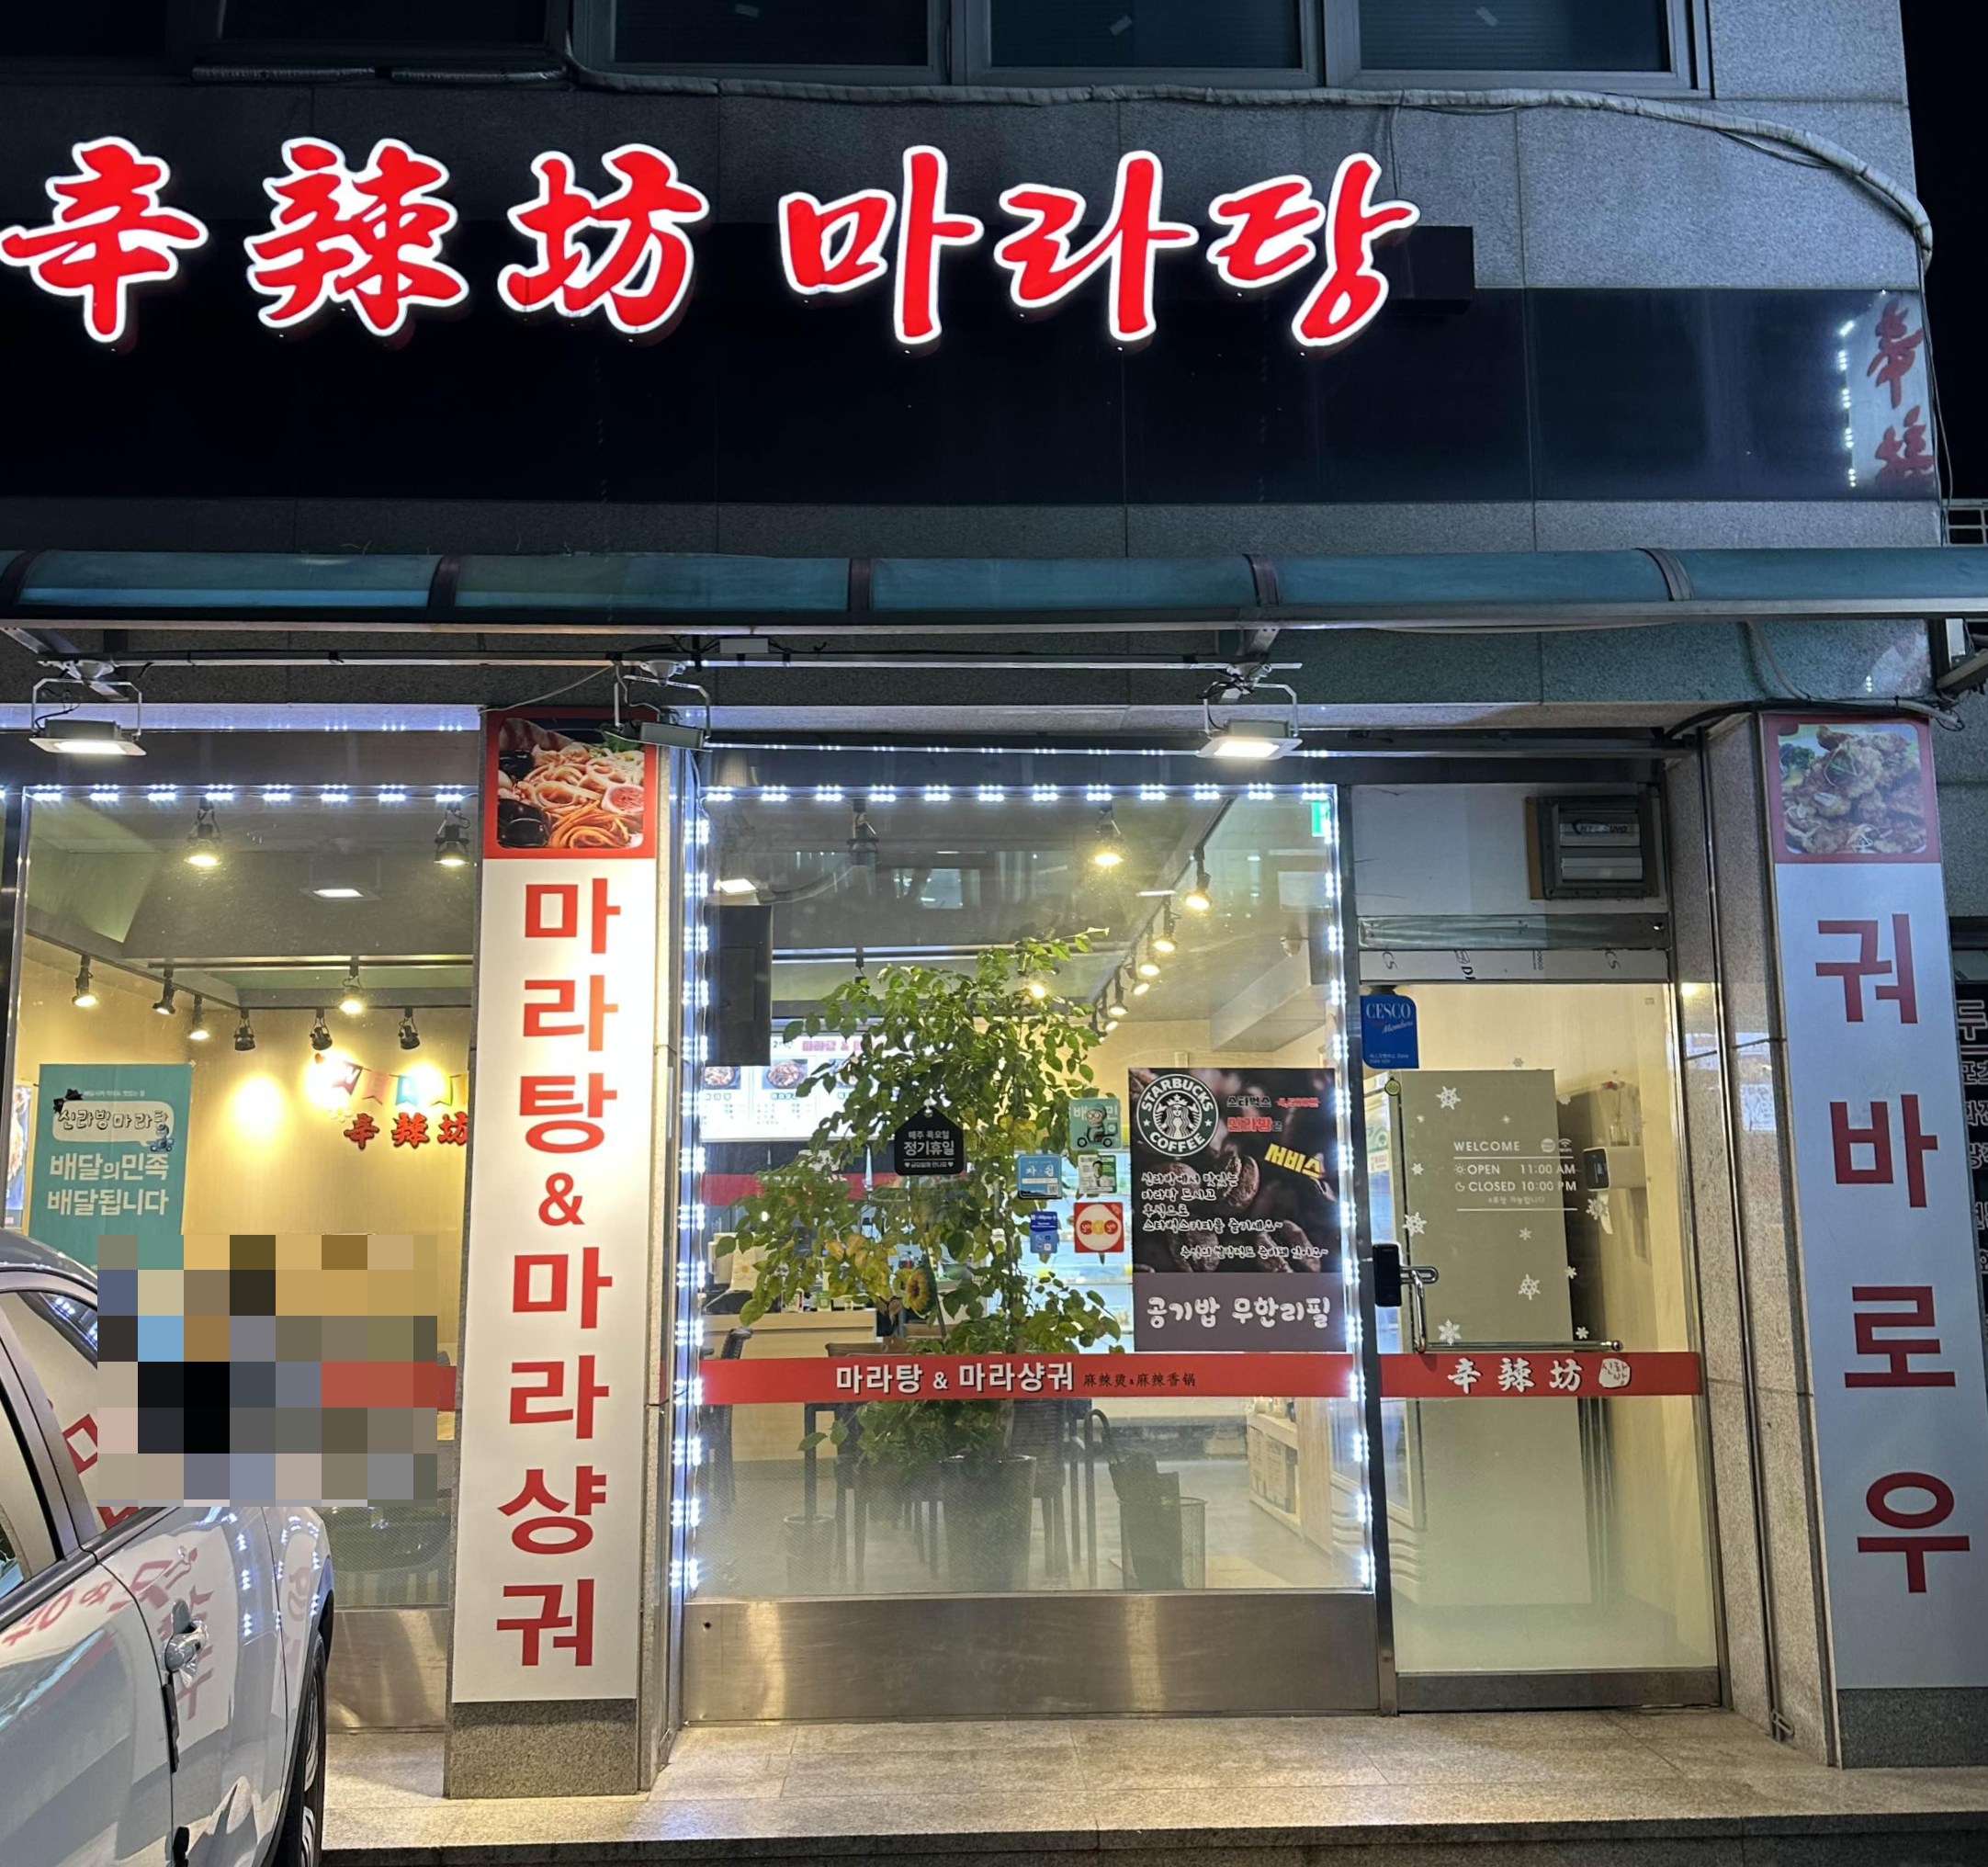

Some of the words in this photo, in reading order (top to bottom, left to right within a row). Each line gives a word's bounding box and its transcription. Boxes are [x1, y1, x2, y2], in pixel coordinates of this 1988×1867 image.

[0, 136, 710, 344] 辛辣坊
[779, 145, 1420, 347] 마라탕
[1366, 1002, 1411, 1020] CESCO
[1141, 1077, 1214, 1113] STARBUCKS
[344, 1112, 469, 1150] 辛辣坊
[926, 1130, 950, 1140] 목요일
[1149, 1131, 1206, 1153] COFFEE
[903, 1140, 954, 1156] 정기휴일
[1453, 1141, 1520, 1152] WELCOME
[50, 1153, 169, 1181] 배달의민족
[1264, 1143, 1323, 1179] 서비스
[1467, 1164, 1500, 1175] OPEN
[1520, 1164, 1553, 1174] 11:00
[1556, 1164, 1576, 1174] AM
[1141, 1171, 1202, 1186] 신라방에서
[1203, 1171, 1239, 1188] 맛있는
[1468, 1181, 1516, 1192] CLOSED
[1521, 1181, 1554, 1192] 10:00
[1557, 1181, 1577, 1192] PM
[47, 1189, 168, 1216] 배달됩니다
[1141, 1187, 1179, 1202] 마라탕
[1180, 1188, 1216, 1201] 드시고
[1142, 1203, 1190, 1218] 후식으로
[1815, 913, 1971, 1593] 궈바로우
[1146, 1296, 1221, 1329] 공기밥
[1232, 1296, 1330, 1329] 무한리필
[836, 1363, 923, 1394] 마라탕
[932, 1371, 948, 1389] &
[959, 1362, 1074, 1393] 마라샹궈
[1447, 1356, 1583, 1395] 辛辣坊
